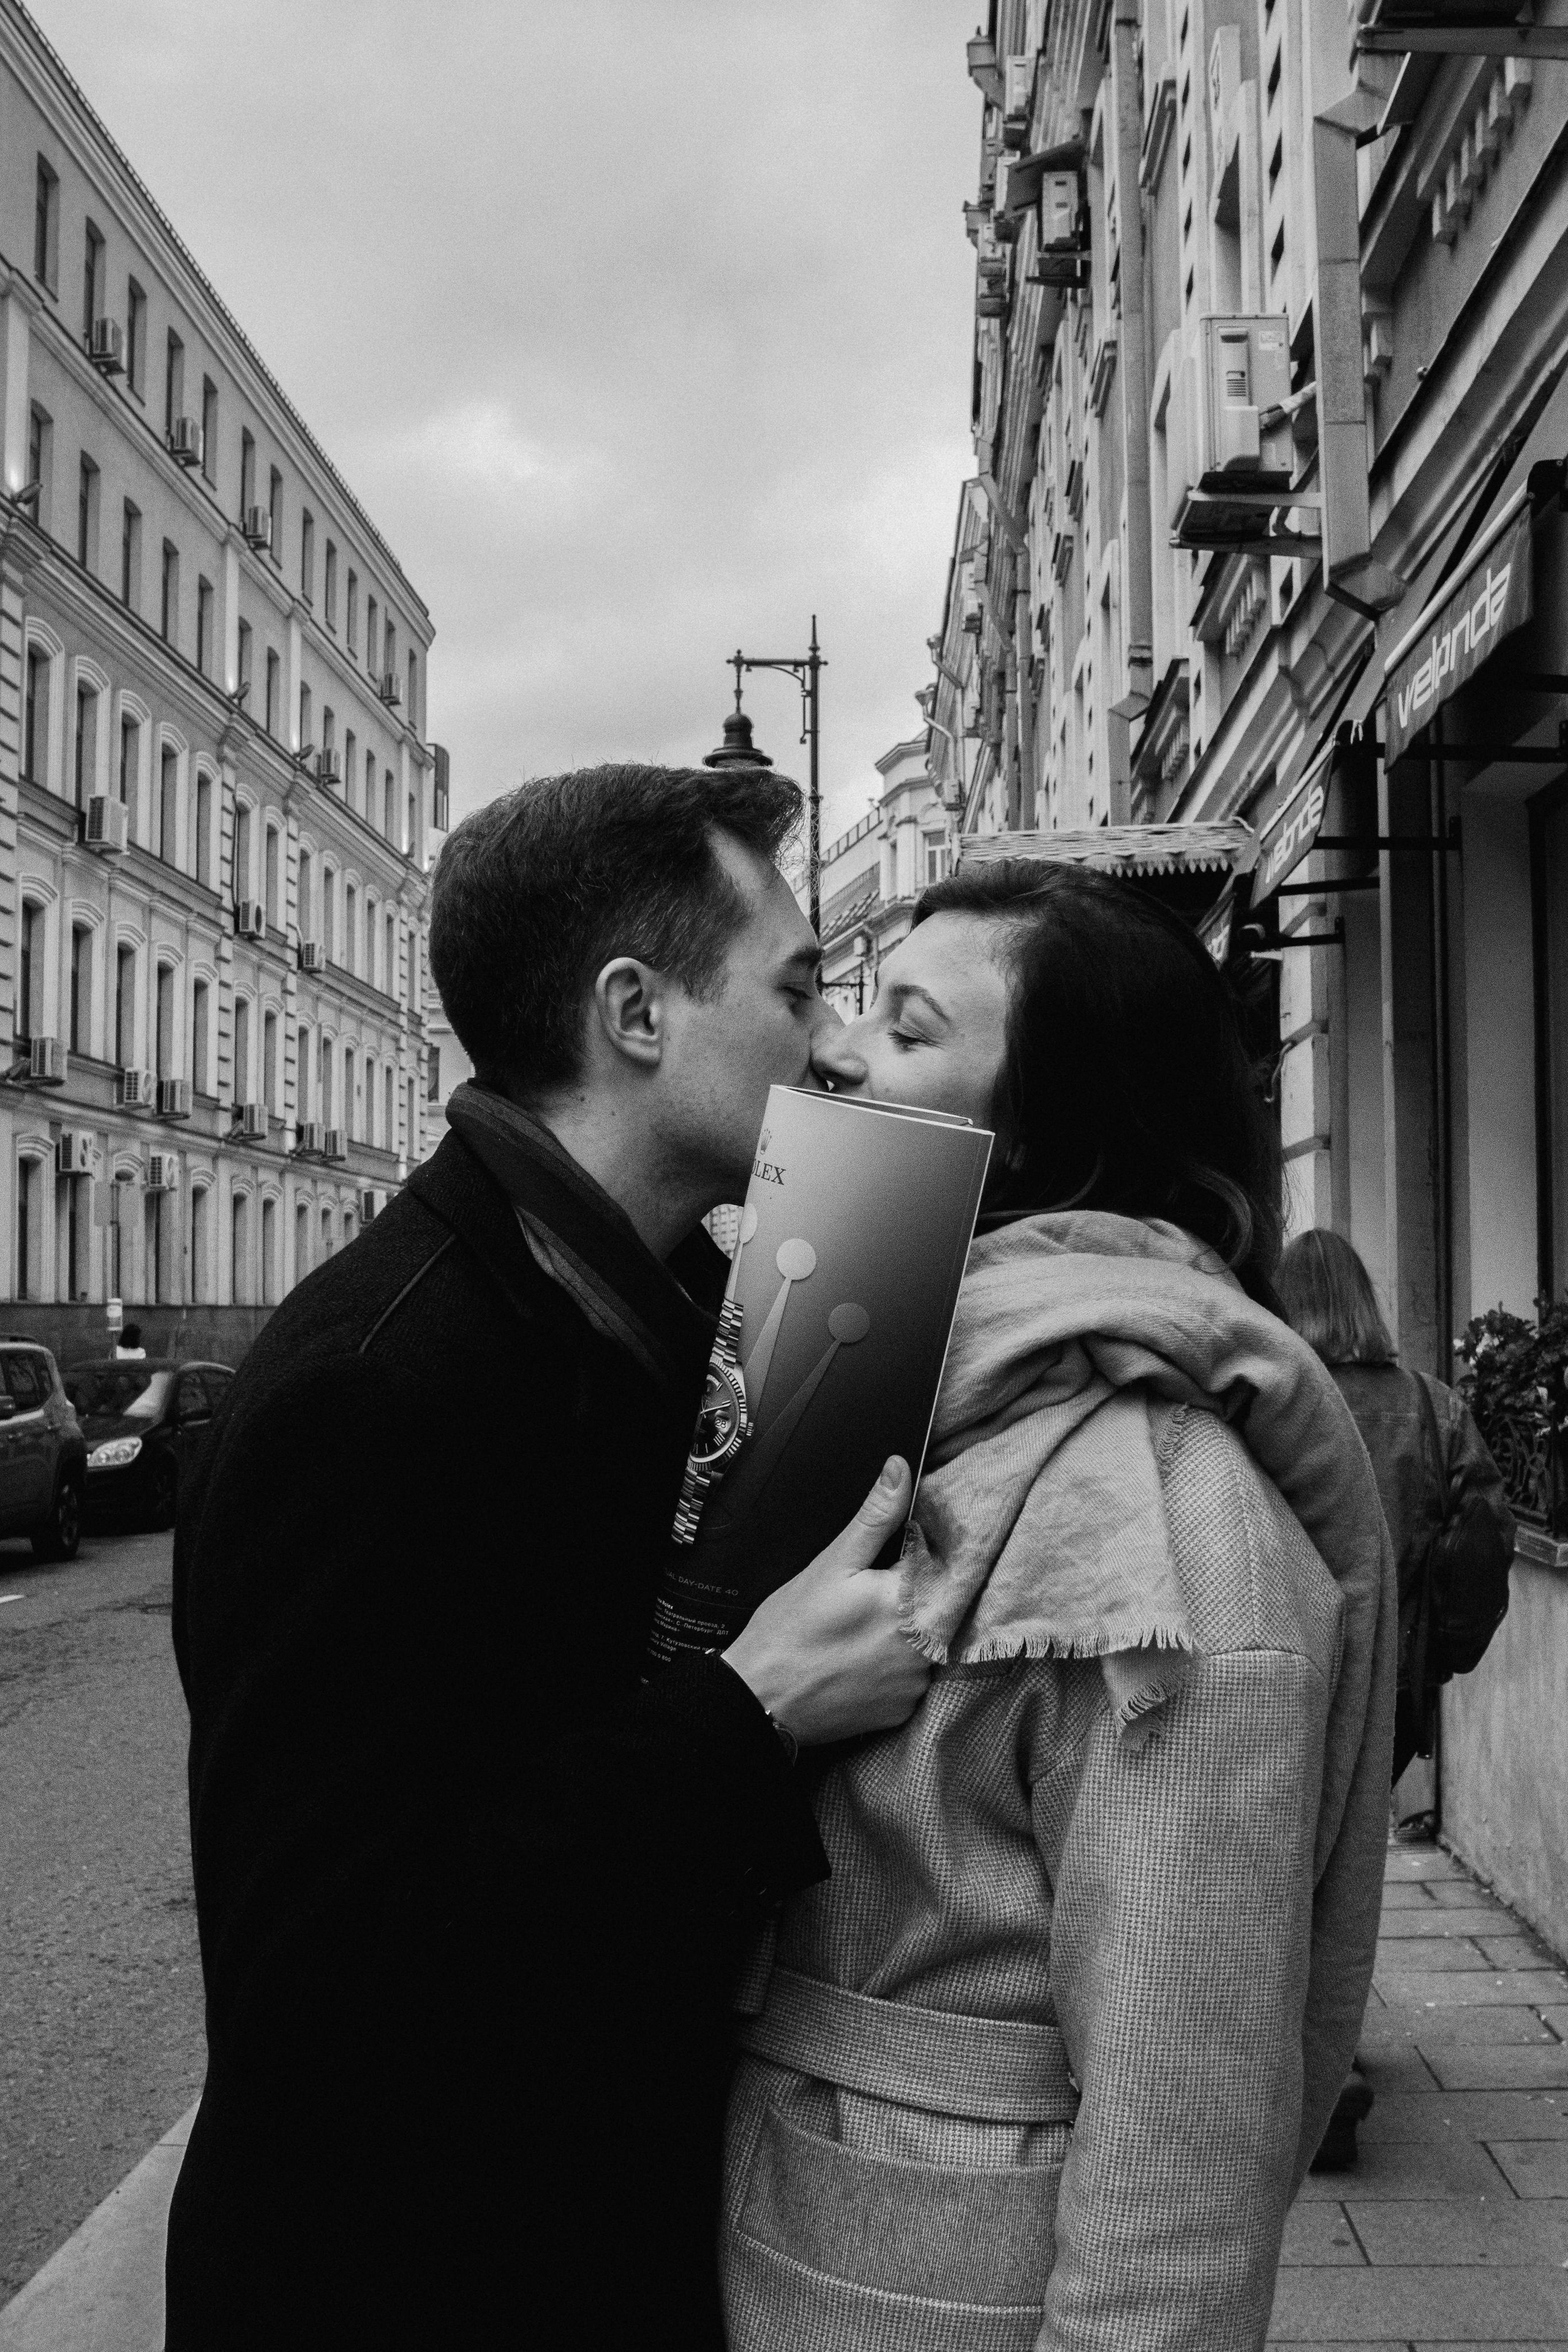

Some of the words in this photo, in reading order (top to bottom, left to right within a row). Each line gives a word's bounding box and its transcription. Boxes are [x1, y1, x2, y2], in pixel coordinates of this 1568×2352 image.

[752, 1158, 786, 1186] OLEX
[715, 1418, 726, 1429] 28
[678, 1576, 723, 1594] DAY-DATE
[725, 1588, 739, 1597] 40
